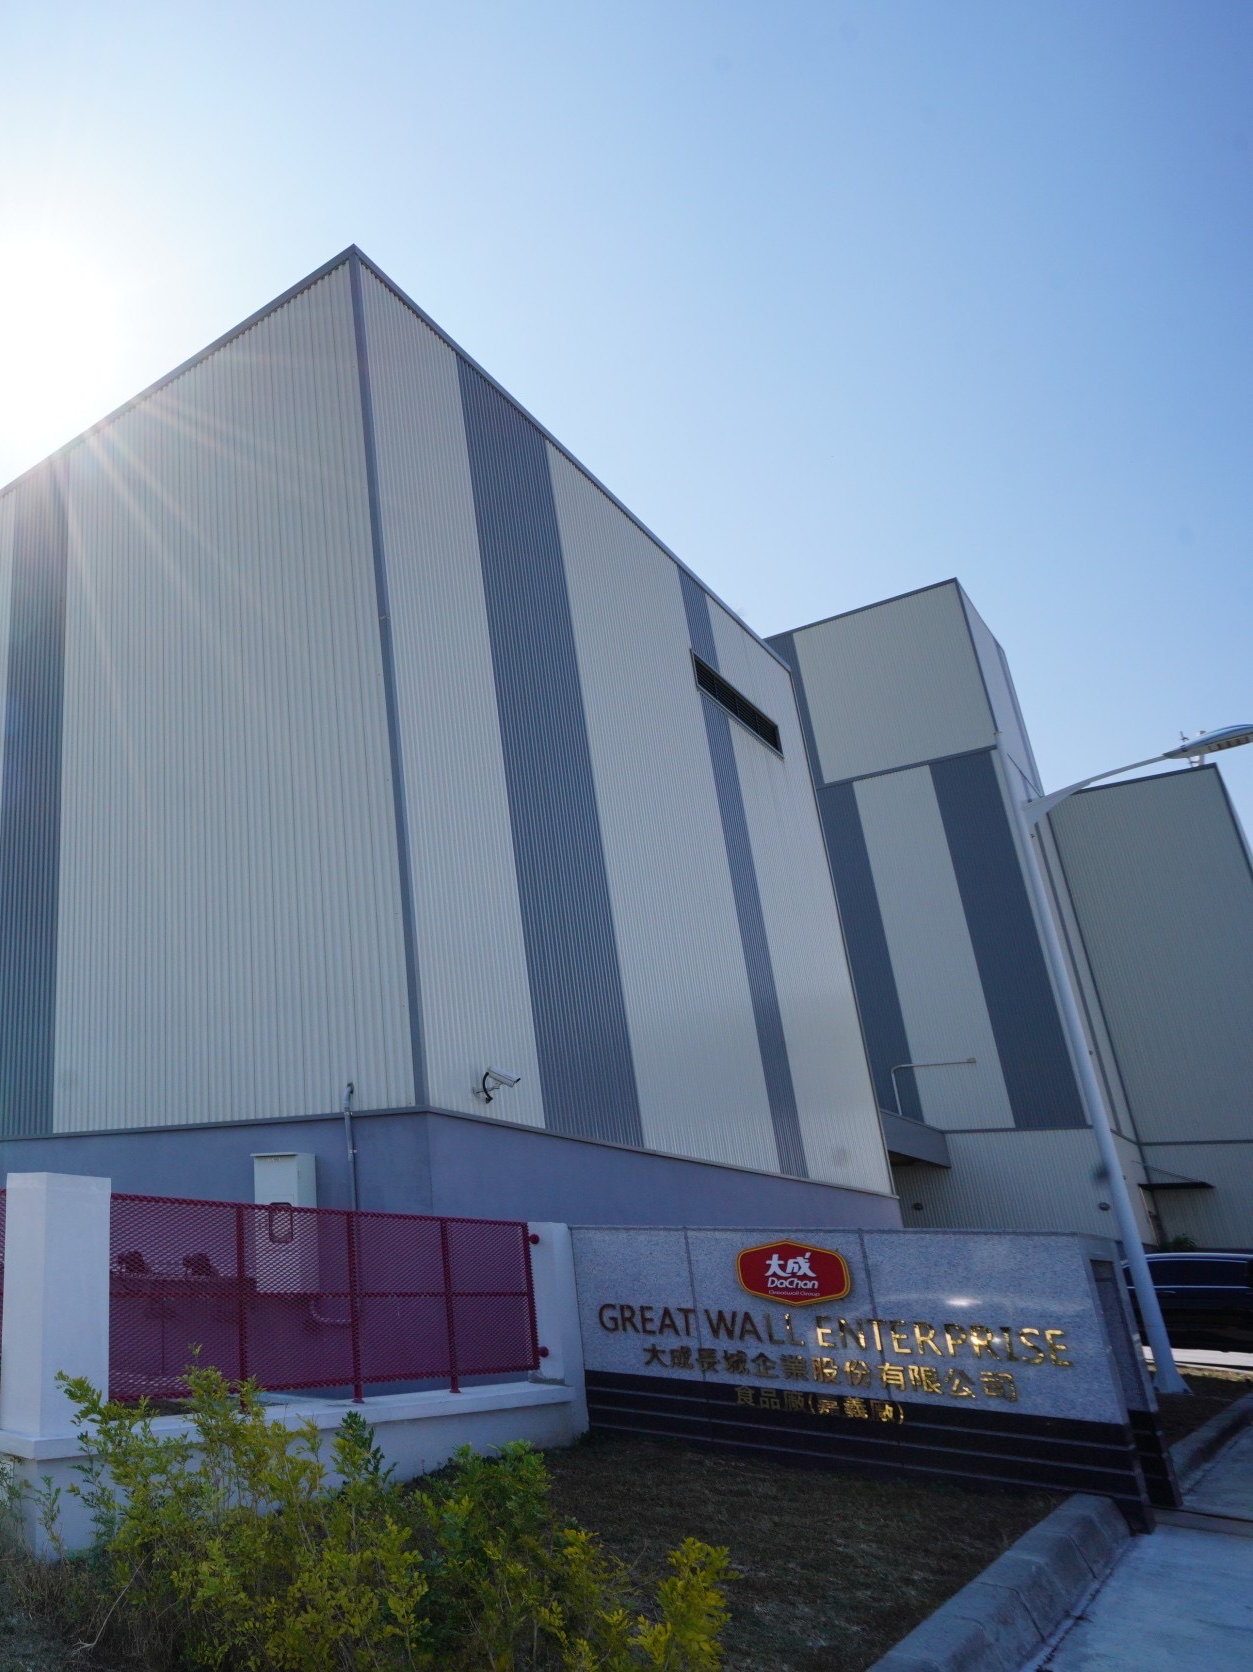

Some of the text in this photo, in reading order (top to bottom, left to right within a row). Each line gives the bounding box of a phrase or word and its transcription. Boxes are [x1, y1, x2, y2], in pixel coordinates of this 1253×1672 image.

[765, 1252, 817, 1277] 大成
[767, 1278, 818, 1289] DaChan
[598, 1303, 1074, 1367] GREAT WALL ENTERPRISE
[643, 1343, 1018, 1401] 大成長城企業股份有限公司
